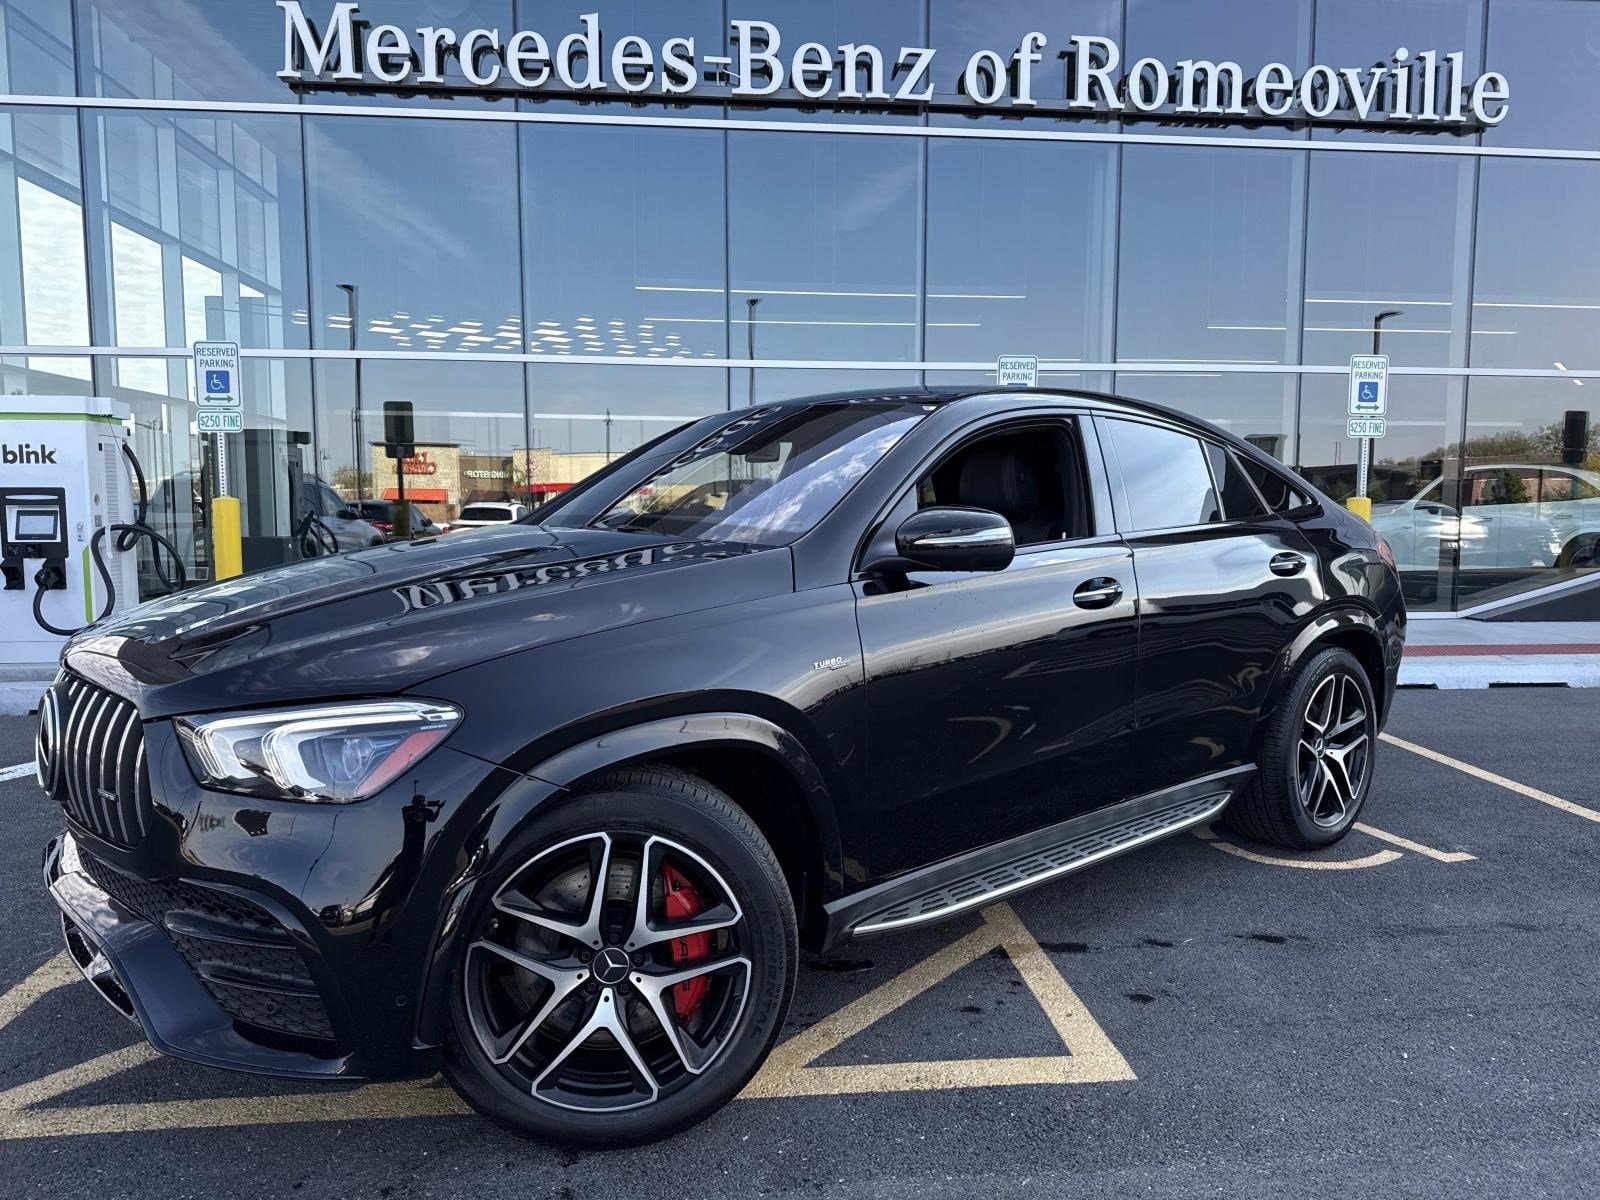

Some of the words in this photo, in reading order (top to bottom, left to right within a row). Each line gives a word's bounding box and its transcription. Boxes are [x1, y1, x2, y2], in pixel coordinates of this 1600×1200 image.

[276, 0, 937, 102] Mercedes-Benz
[966, 32, 1047, 105] of
[1069, 34, 1510, 124] Romeoville
[196, 347, 236, 357] RESERVED
[199, 359, 234, 368] PARKING
[1000, 361, 1036, 370] RESERVED
[1353, 360, 1386, 369] RESERVED
[1002, 372, 1033, 381] PARKING
[1354, 371, 1383, 380] PARKING
[200, 415, 221, 428] $250
[223, 415, 240, 428] FINE
[1350, 422, 1367, 434] $250
[1368, 422, 1384, 434] FINE
[2, 443, 57, 465] blink
[813, 657, 842, 668] TURBO
